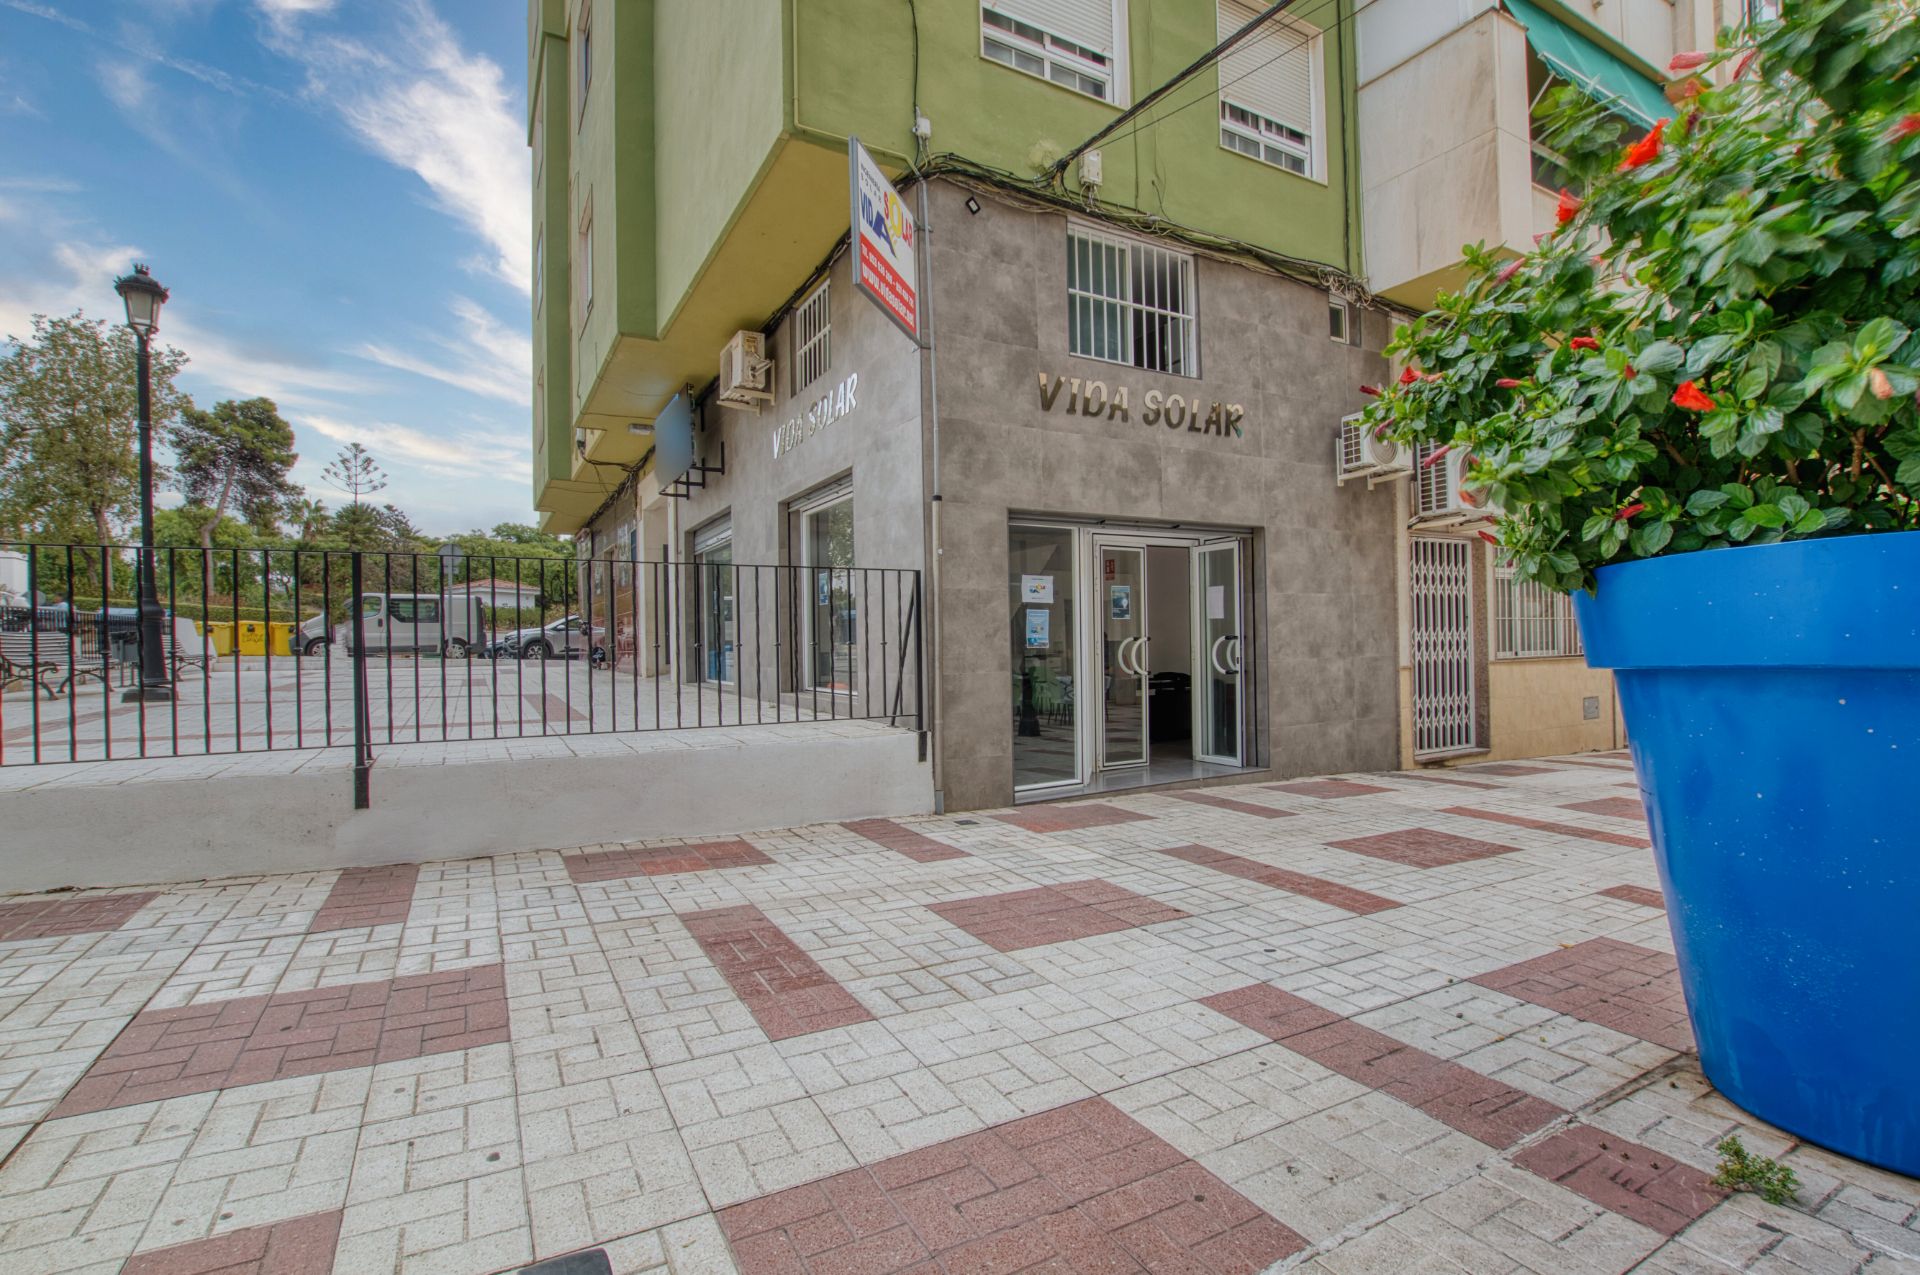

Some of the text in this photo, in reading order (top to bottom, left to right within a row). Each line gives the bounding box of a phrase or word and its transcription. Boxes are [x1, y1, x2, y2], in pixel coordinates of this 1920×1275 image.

[860, 186, 896, 258] VIDA
[883, 190, 912, 248] SOLAR
[772, 372, 858, 459] VIDA SOLAR
[1038, 372, 1244, 439] VIDA SOLAR
